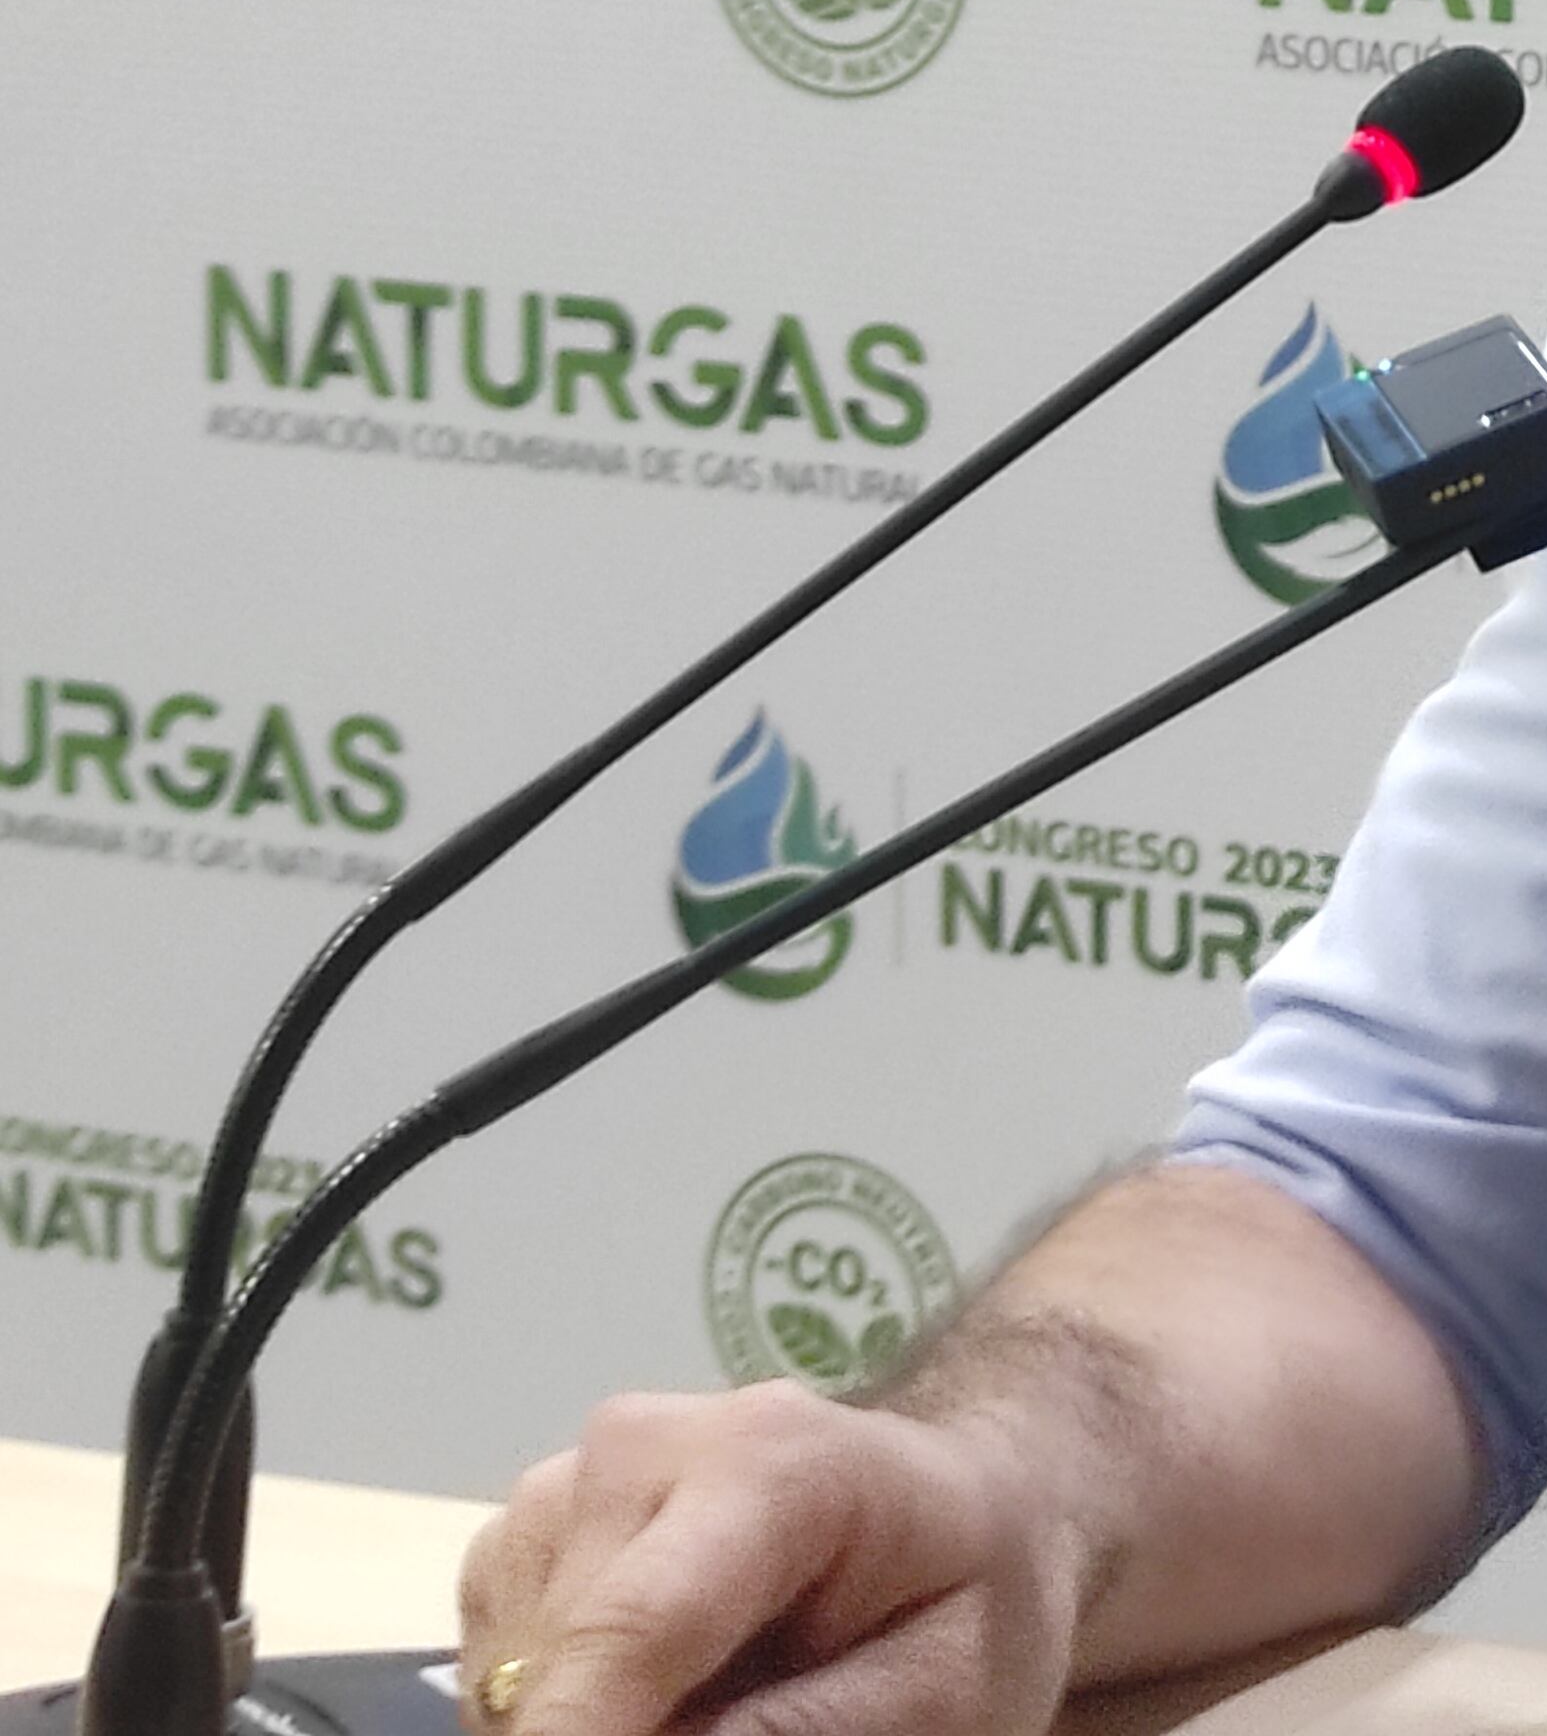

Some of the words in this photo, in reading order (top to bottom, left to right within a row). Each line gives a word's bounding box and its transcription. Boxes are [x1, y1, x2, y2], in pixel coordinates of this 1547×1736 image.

[204, 264, 930, 447] NATURGAS
[953, 816, 1198, 877] ONGRESO
[941, 864, 1320, 982] NATUR
